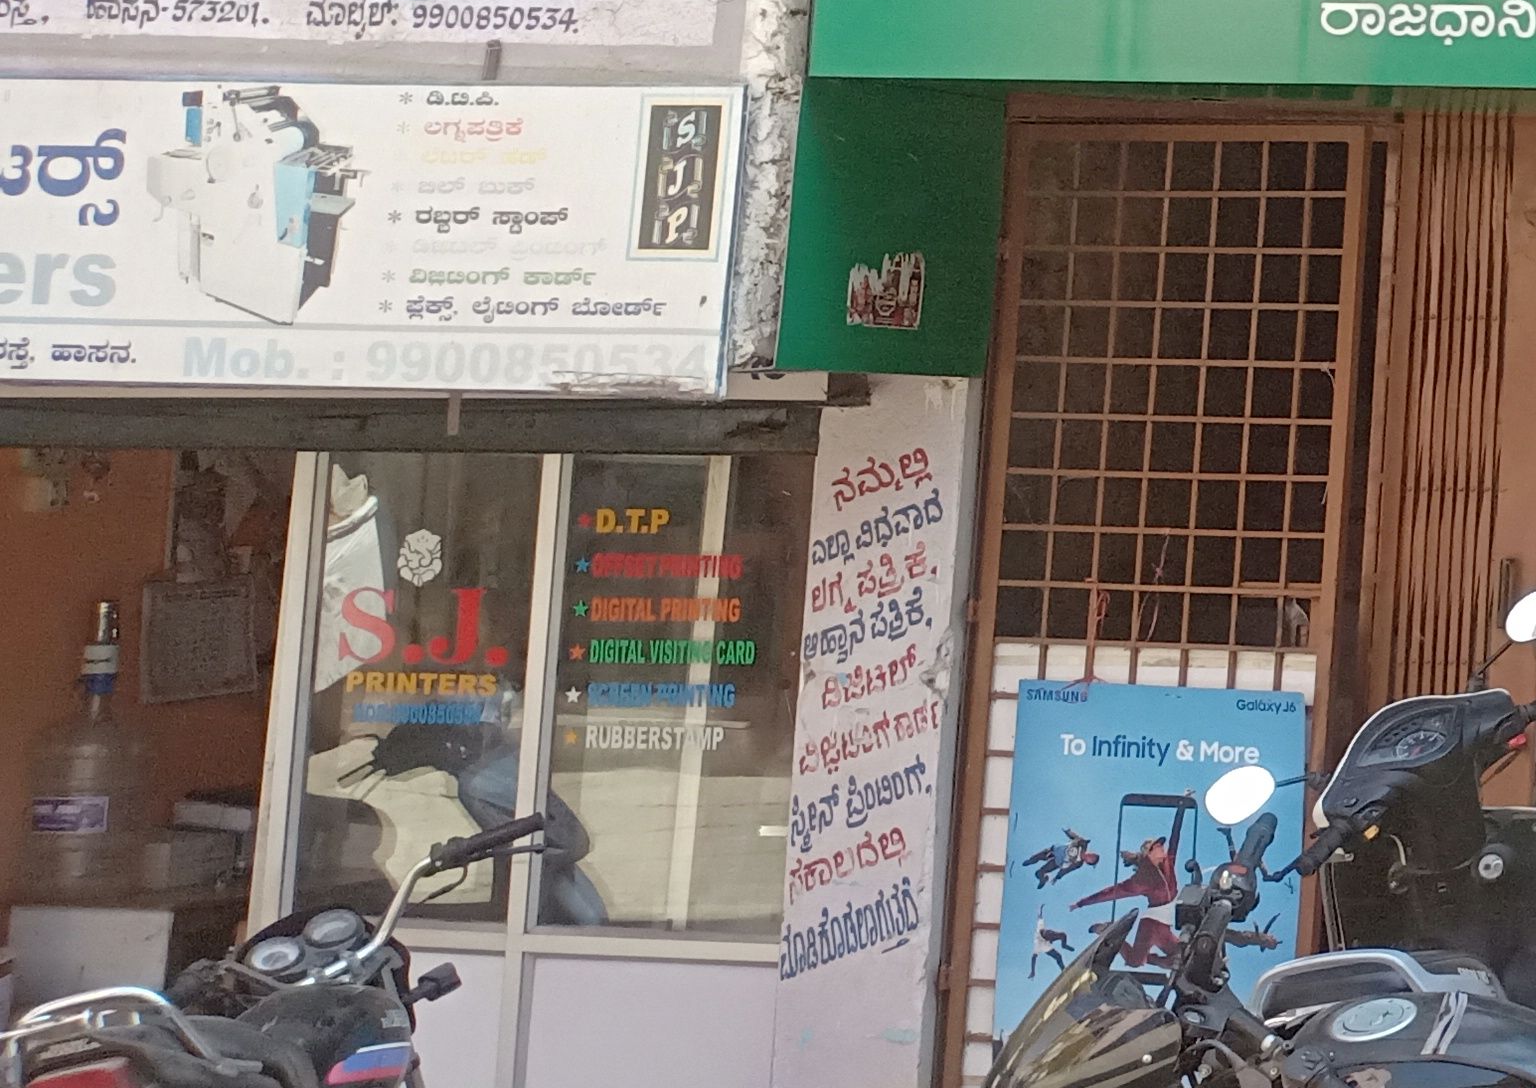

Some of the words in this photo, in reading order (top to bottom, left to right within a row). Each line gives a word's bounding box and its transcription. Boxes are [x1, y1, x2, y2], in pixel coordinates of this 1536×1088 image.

[184, 337, 308, 381] Mob.
[596, 508, 670, 534] D.T.P
[590, 597, 657, 622] DIGITAL
[660, 597, 741, 622] PRINTING
[338, 586, 510, 667] S.J.
[589, 638, 646, 664] DIGITAL
[650, 639, 713, 665] VISITING
[716, 640, 756, 665] CARD
[345, 671, 498, 697] PRINTERS
[1026, 688, 1089, 703] SAMSUNG
[1236, 699, 1281, 715] Galaxy
[1282, 700, 1297, 714] J6
[585, 724, 725, 751] RUBBERSTAMP
[1060, 733, 1086, 756] To
[1092, 734, 1171, 766] Infinity
[1176, 740, 1194, 762] &
[1199, 741, 1260, 765] More
